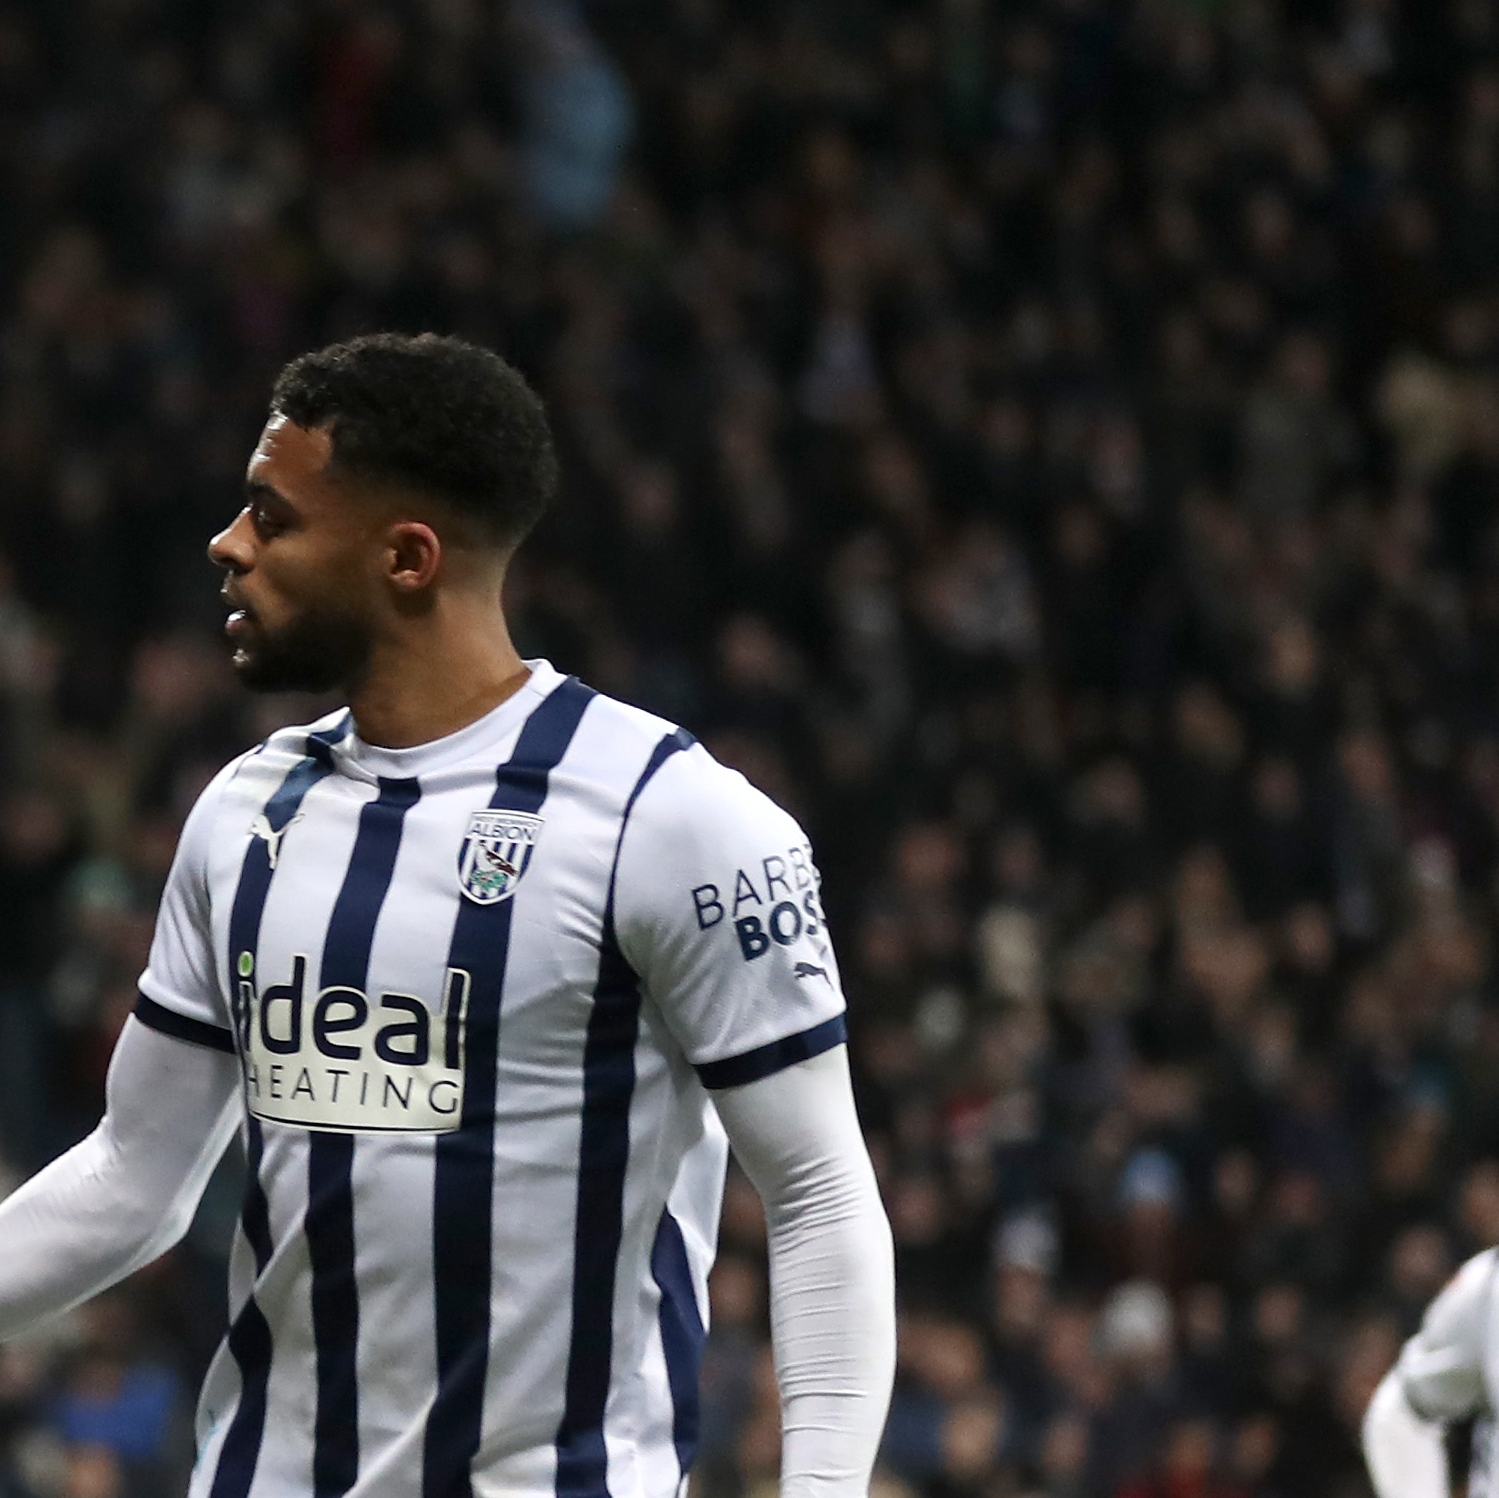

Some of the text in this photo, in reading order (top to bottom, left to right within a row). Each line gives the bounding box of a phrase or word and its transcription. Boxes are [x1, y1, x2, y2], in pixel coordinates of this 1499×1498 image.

[691, 844, 821, 931] BARB
[734, 890, 826, 961] BOS
[237, 951, 466, 1070] ideal
